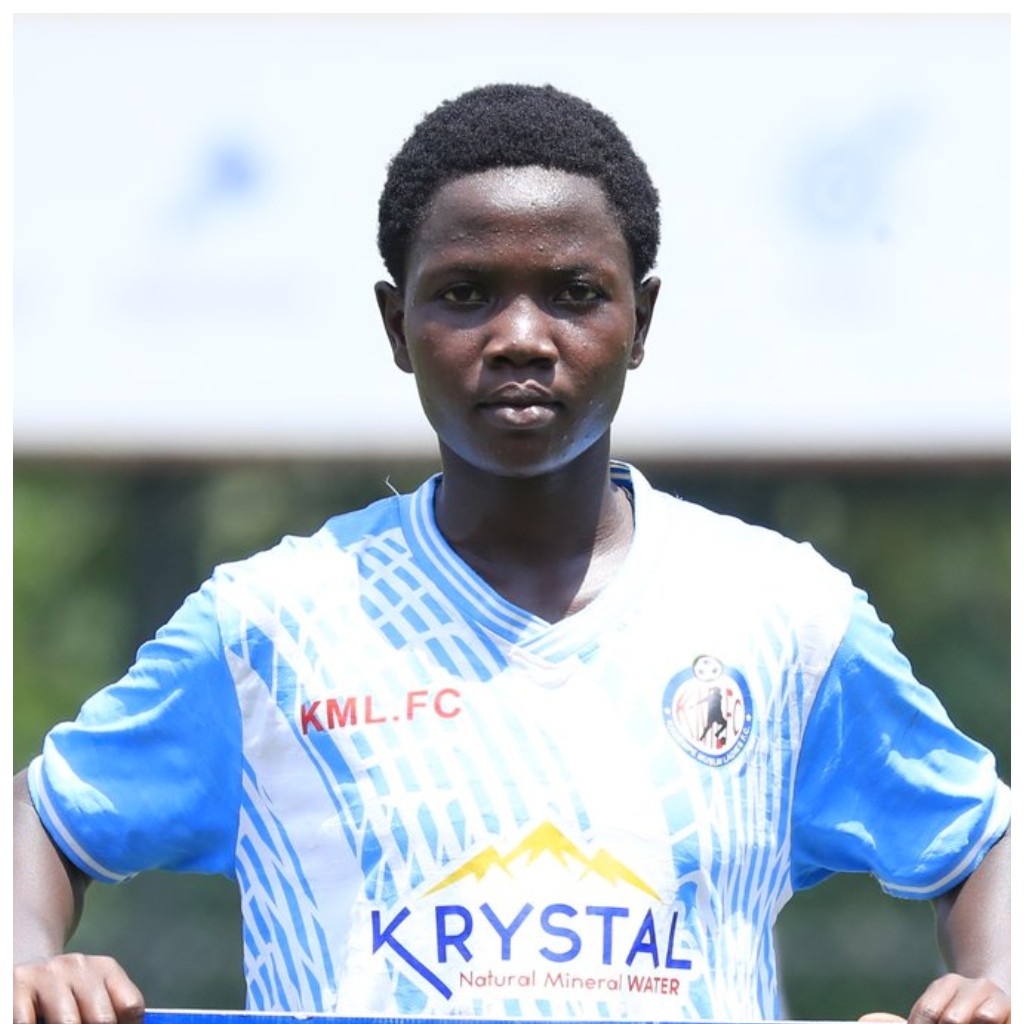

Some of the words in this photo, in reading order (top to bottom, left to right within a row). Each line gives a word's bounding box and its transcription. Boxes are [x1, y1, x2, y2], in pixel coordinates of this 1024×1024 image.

[300, 688, 462, 735] KML.FC
[372, 900, 692, 1000] KRYSTAL
[459, 970, 536, 988] Natural
[544, 973, 622, 991] Mineral
[627, 974, 681, 995] WATER
